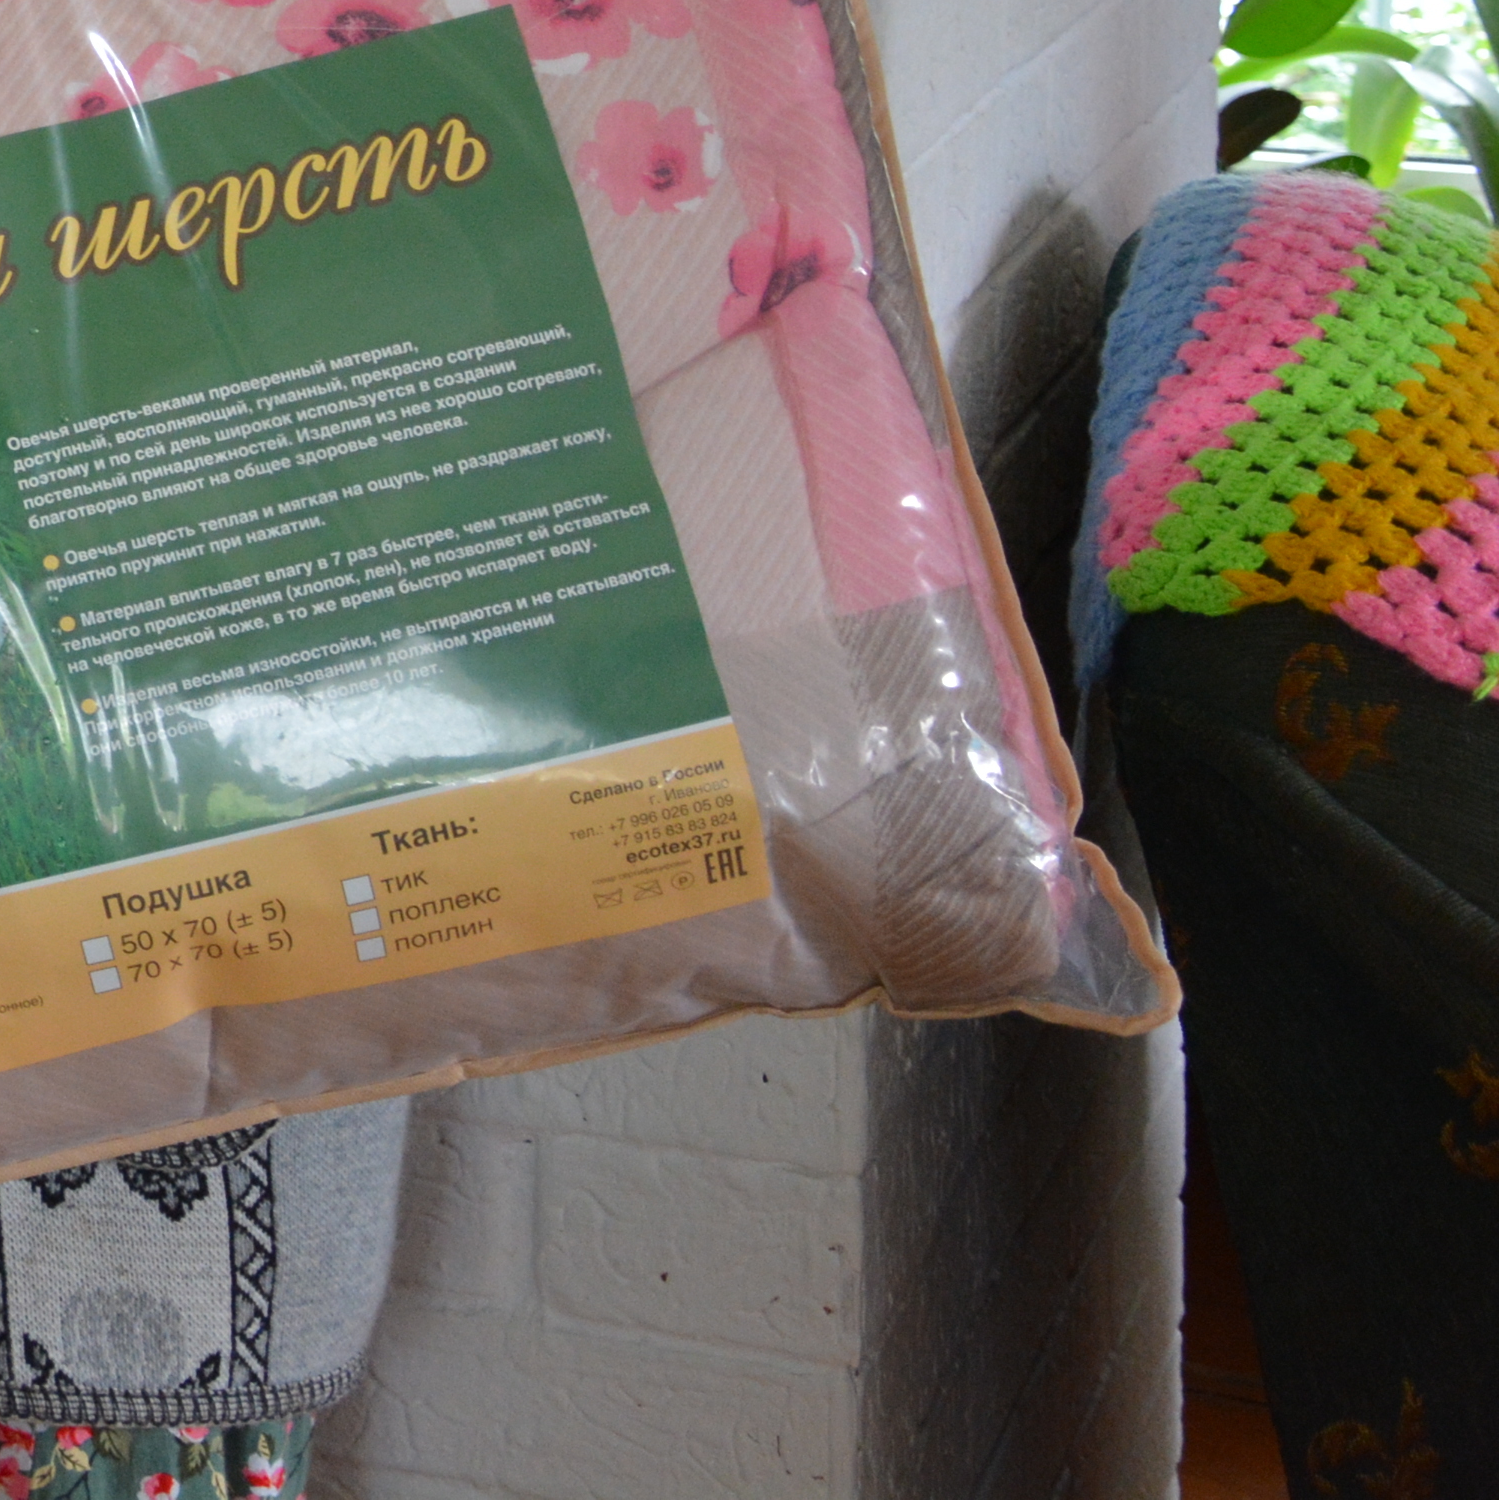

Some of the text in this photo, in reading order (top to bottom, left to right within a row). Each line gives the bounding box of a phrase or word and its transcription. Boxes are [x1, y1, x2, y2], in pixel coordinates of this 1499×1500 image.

[52, 115, 488, 287] шерсть
[6, 341, 418, 450] Овечья шерсть-веками проверенный материал,
[13, 434, 112, 473] доступный,
[256, 377, 347, 411] гуманный,
[351, 356, 443, 387] прекрасно
[446, 324, 571, 363] согревающий,
[17, 462, 89, 490] поэтому
[93, 458, 105, 470] и
[109, 452, 131, 467] по
[134, 441, 166, 460] сей
[170, 435, 211, 454] день
[296, 384, 415, 421] используется
[419, 380, 430, 392] в
[433, 360, 516, 388] создании
[23, 363, 602, 509] постельный принадлежностей. Изделия из нее хорошо согревают,
[28, 416, 468, 529] благотворно влияют на общее здоровье человека.
[64, 427, 611, 564] Овечья шерсть теплая и мягкая на ощупь, не раздражает кожу,
[45, 516, 325, 592] приятно пружинит при нажатии.
[80, 493, 608, 626] Материал впитывает влагу в 7 раз быстрее, чем ткани расти-
[569, 759, 724, 804] Сделано в России
[648, 777, 729, 805] г. Иваново
[370, 817, 478, 854] Ткань:
[569, 793, 734, 840] тел.: +7 996 026 05 09
[613, 811, 737, 847] +7 915 83 83 824
[626, 829, 741, 863] ecotex37.ru
[102, 870, 251, 919] Подушка
[380, 870, 428, 893] тик
[389, 887, 500, 924] поплекс
[121, 930, 153, 954] 50
[183, 916, 217, 937] 70
[227, 910, 253, 934] (±
[261, 899, 286, 923] 5)
[394, 917, 493, 951] поплин
[127, 960, 161, 982] 70
[189, 943, 223, 960] 70
[233, 940, 259, 959] (±
[268, 929, 293, 952] 5)
